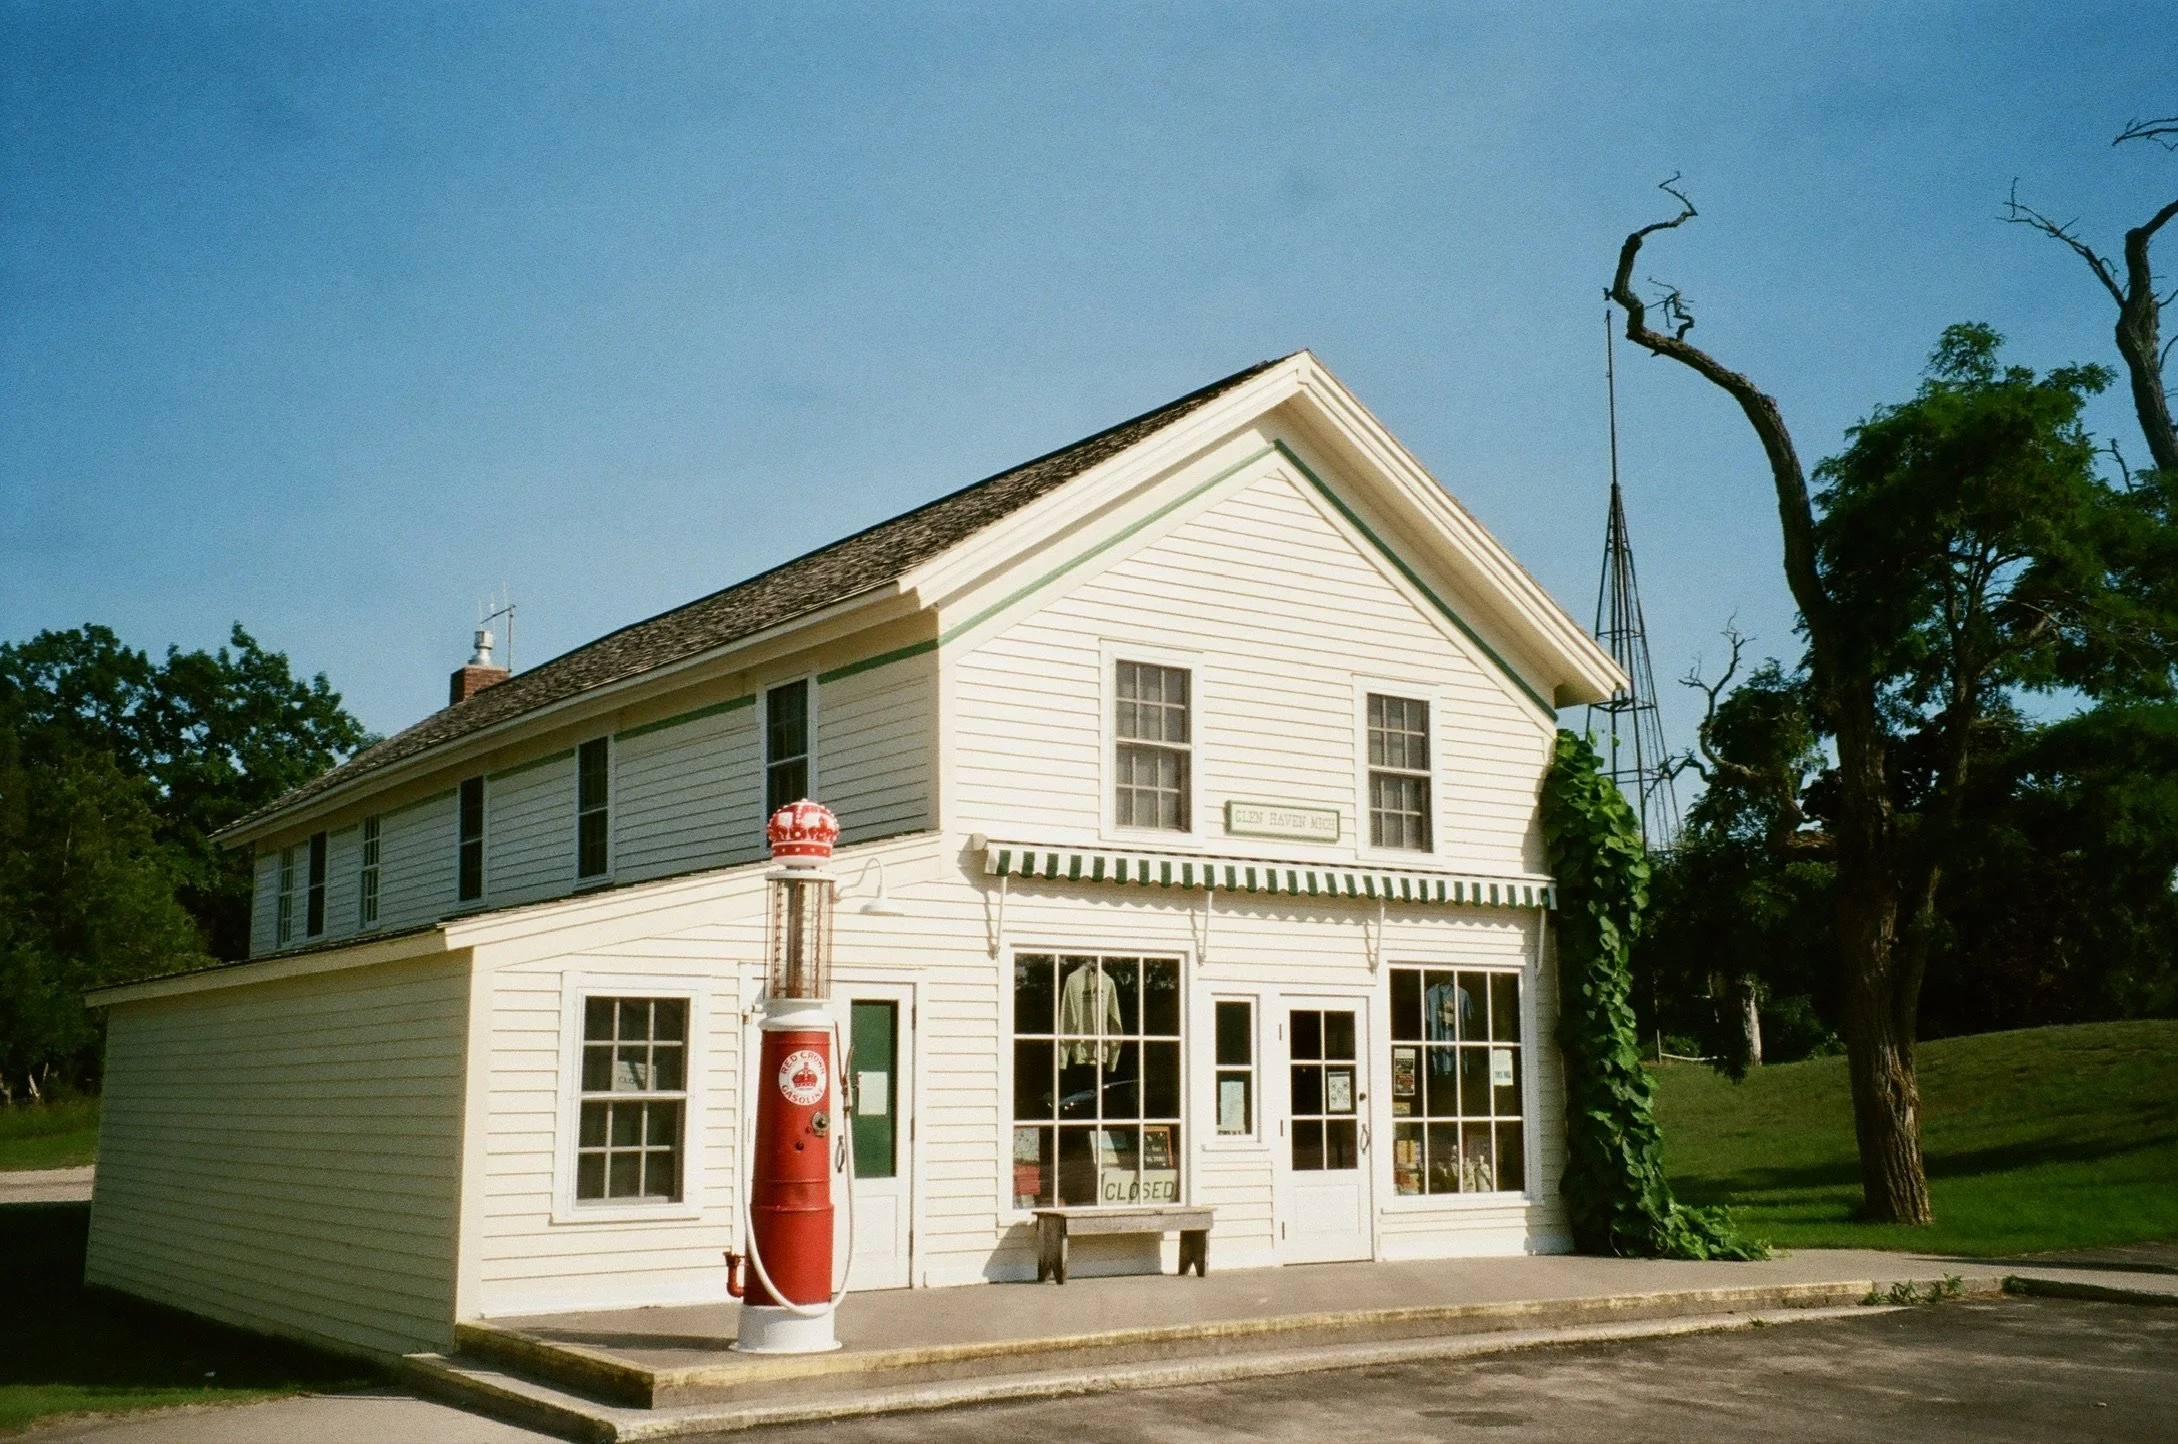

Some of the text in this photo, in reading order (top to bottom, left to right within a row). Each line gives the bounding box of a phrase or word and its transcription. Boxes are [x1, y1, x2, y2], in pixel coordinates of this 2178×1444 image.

[1234, 810, 1336, 830] GLEN HAVEN MICH
[781, 1052, 825, 1074] RED CROWN
[1105, 1181, 1175, 1201] CLOSED
